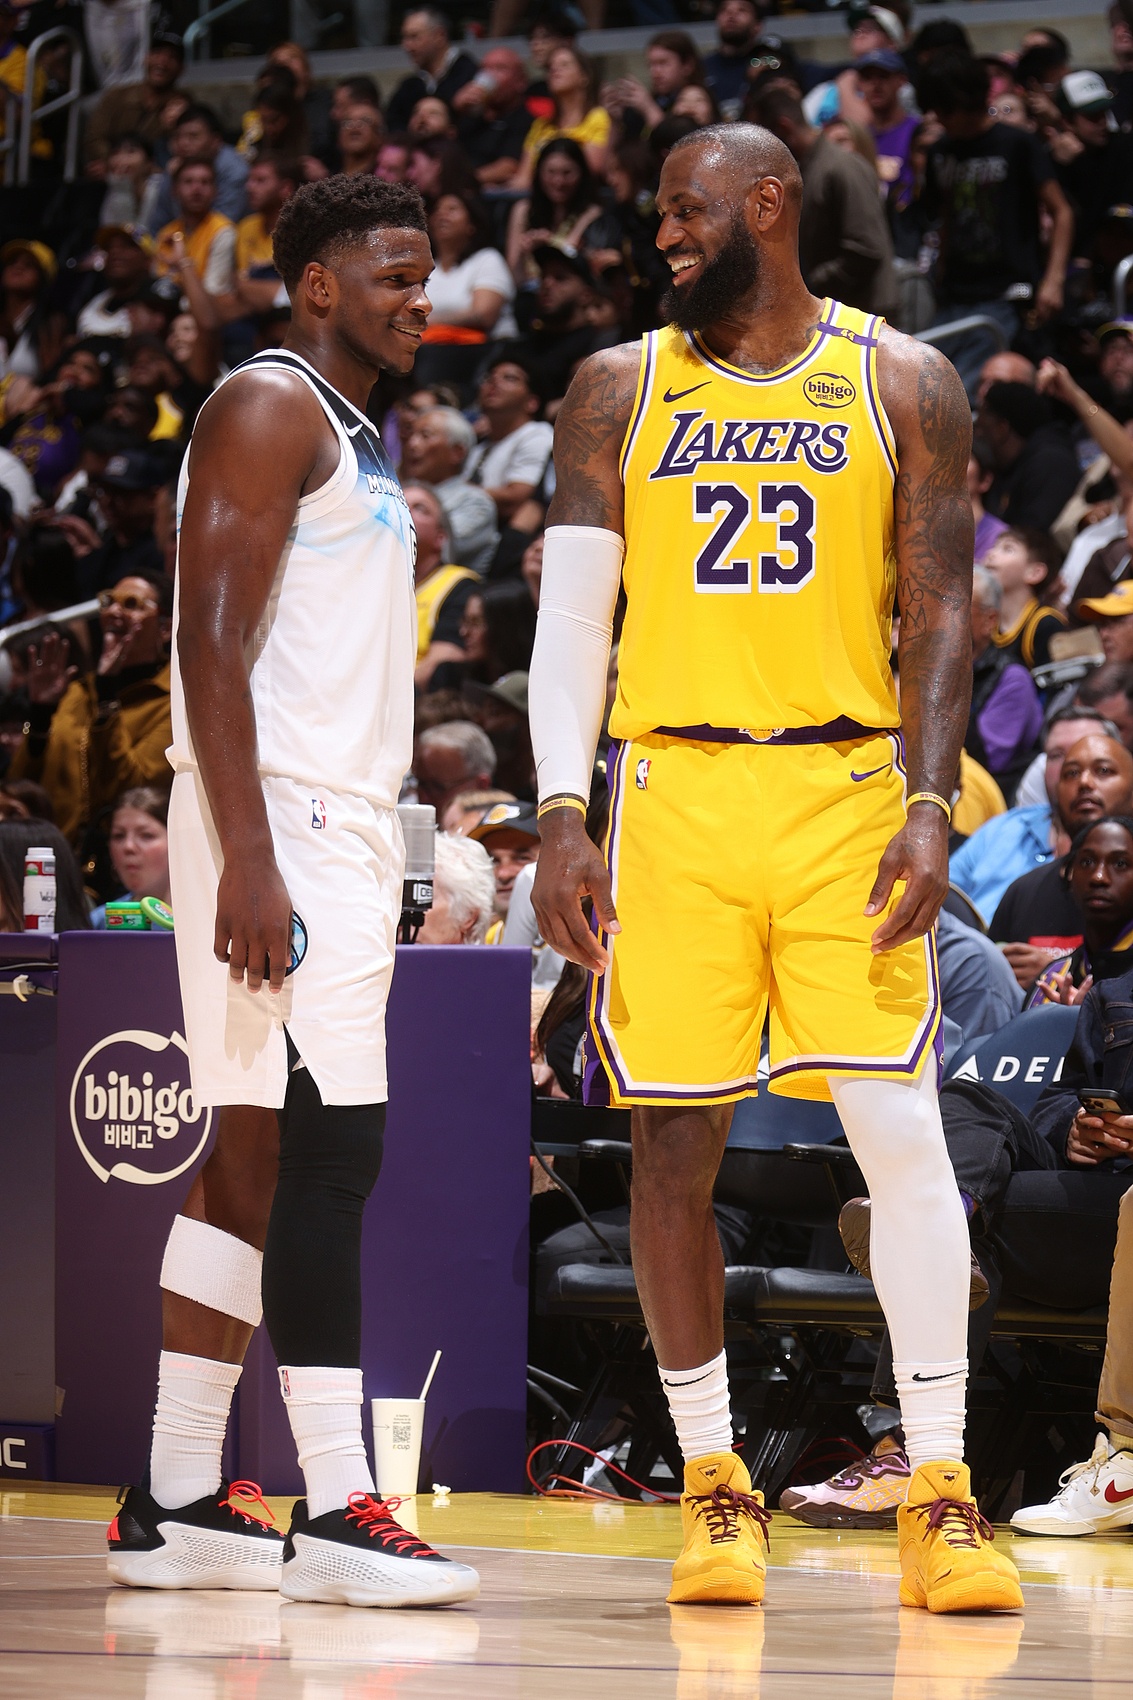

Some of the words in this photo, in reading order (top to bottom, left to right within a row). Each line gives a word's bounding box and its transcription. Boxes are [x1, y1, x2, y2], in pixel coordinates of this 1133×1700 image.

[841, 329, 855, 341] 44
[808, 381, 853, 399] bibigo
[648, 409, 851, 482] LAKERS
[692, 482, 817, 594] 23
[84, 1070, 202, 1140] bibigo
[104, 1123, 154, 1149] 비비고
